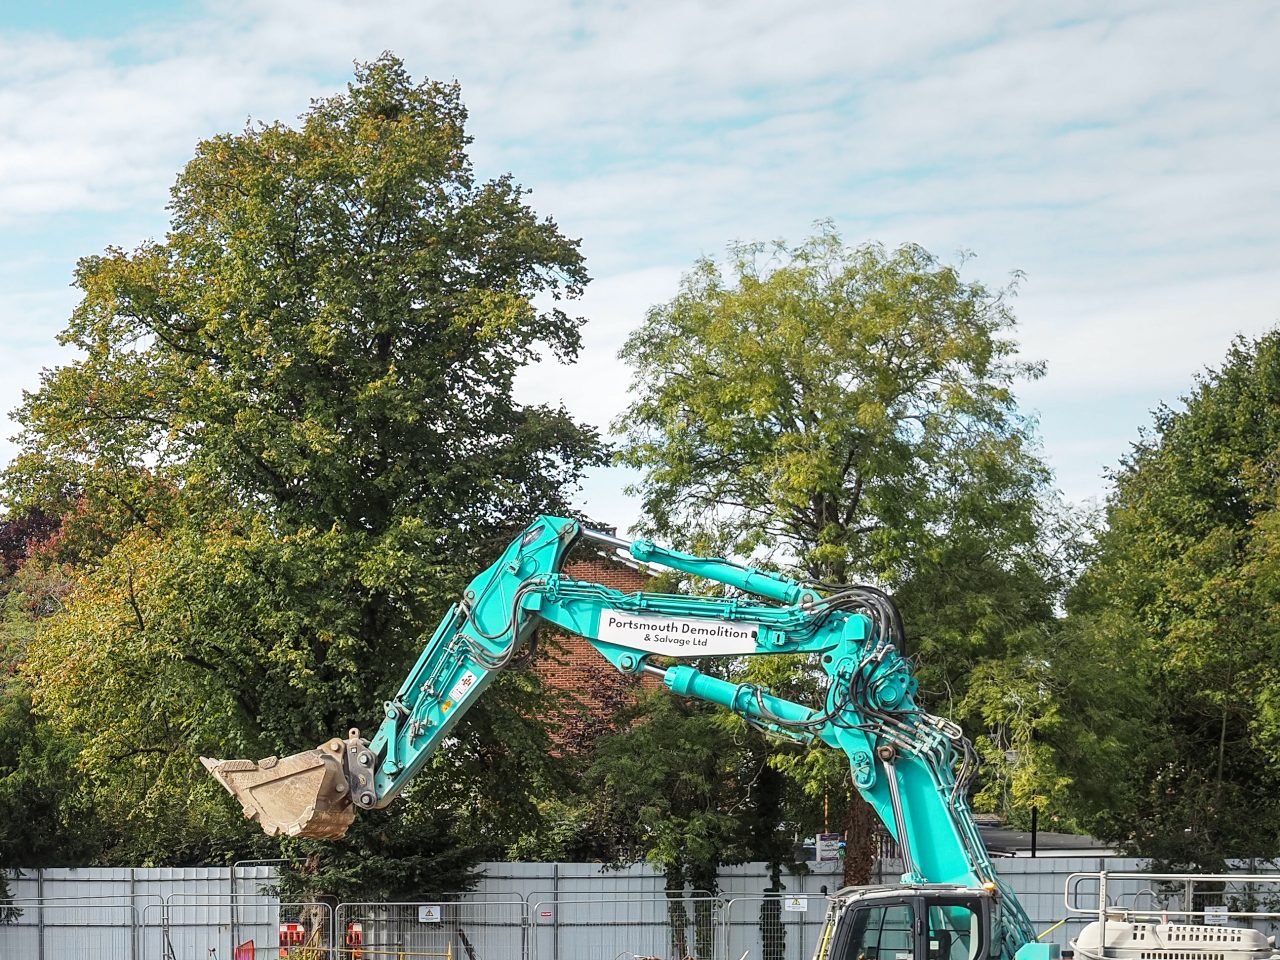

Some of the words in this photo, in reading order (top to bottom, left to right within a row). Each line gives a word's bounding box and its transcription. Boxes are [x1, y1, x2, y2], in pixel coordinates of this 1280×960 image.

[608, 617, 678, 633] Portsmouth
[681, 624, 748, 639] Demolition
[653, 634, 691, 647] Salvage
[692, 638, 708, 647] Ltd
